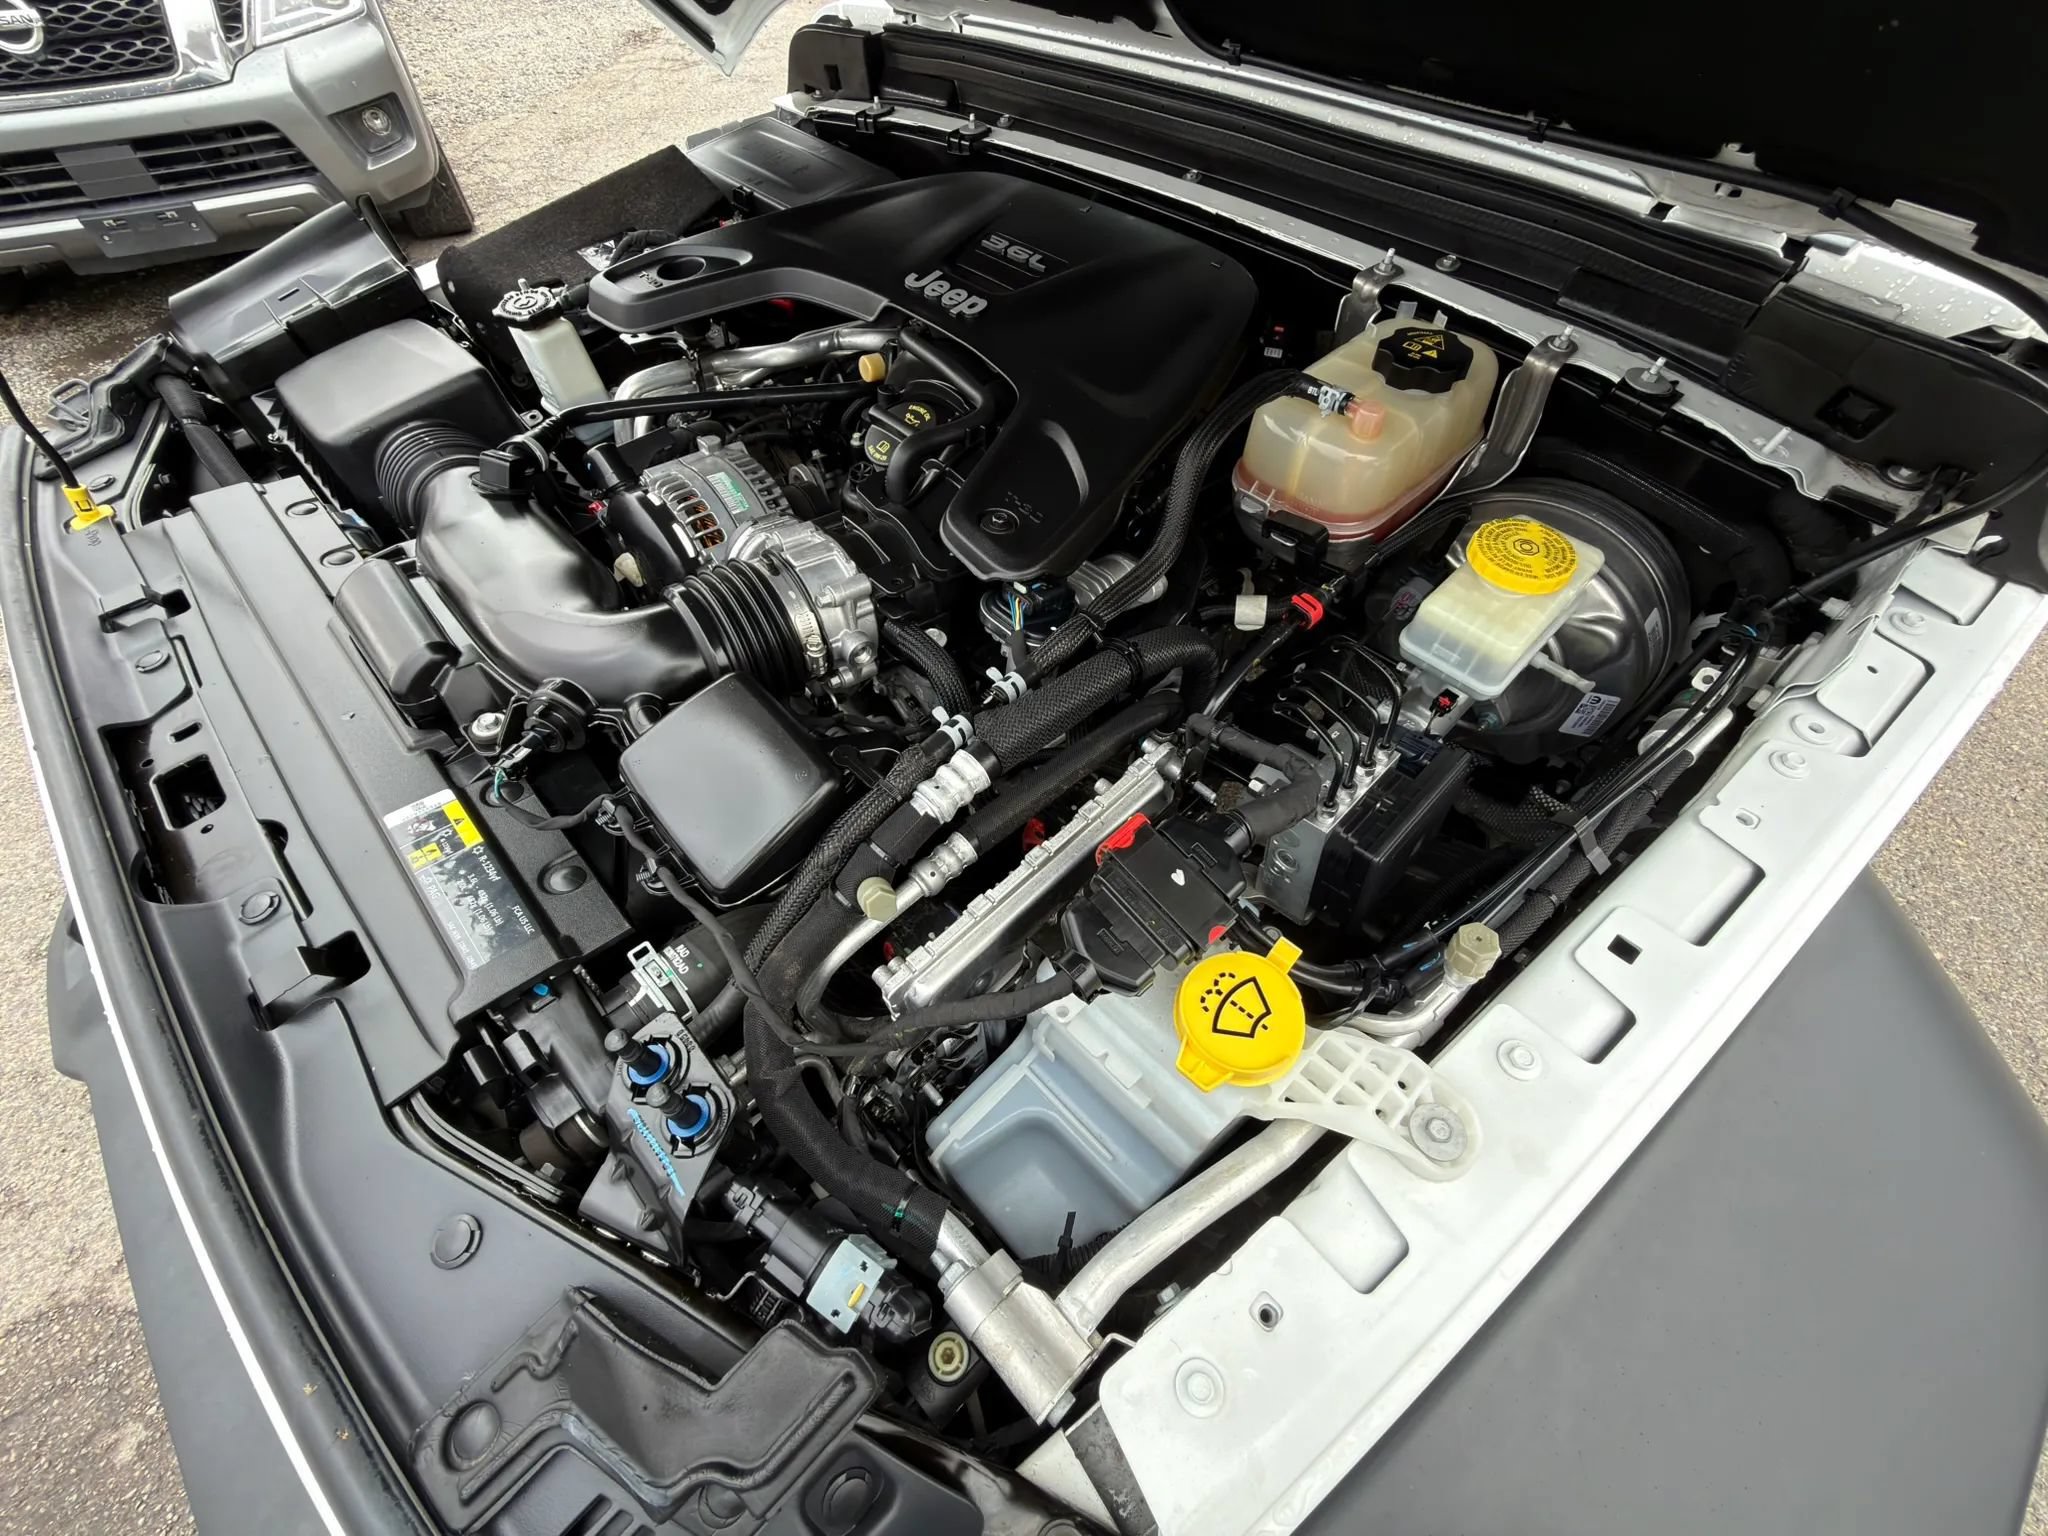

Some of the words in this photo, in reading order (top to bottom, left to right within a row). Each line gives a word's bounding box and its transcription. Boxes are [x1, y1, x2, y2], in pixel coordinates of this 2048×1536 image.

[904, 270, 988, 317] Jeep
[478, 855, 501, 882] R-1234yf
[511, 904, 524, 917] FCA
[523, 923, 536, 934] LLC
